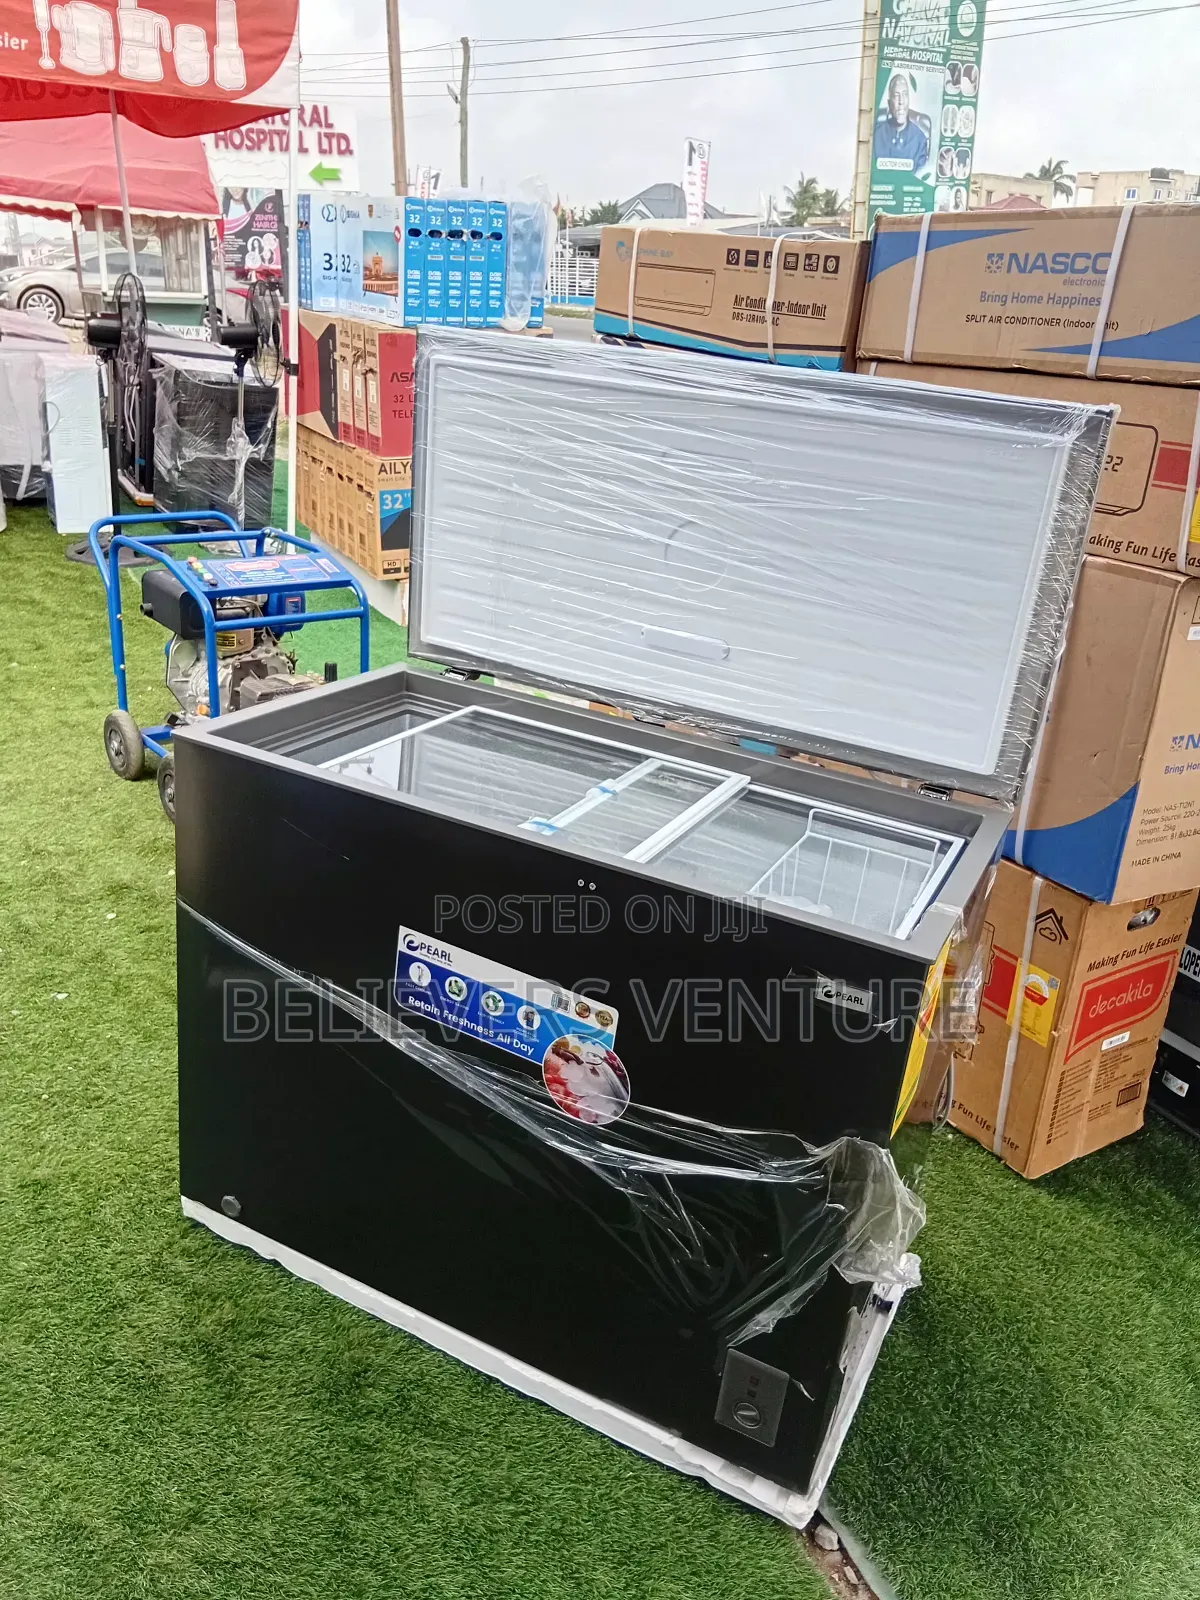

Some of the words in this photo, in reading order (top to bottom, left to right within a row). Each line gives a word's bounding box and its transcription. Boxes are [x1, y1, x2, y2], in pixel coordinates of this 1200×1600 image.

[911, 51, 943, 63] HOSPITAL
[317, 131, 354, 155] LTD.
[409, 214, 421, 224] 32
[430, 215, 442, 225] 32
[451, 216, 462, 226] 32
[472, 217, 483, 226] 32
[492, 218, 503, 228] 32
[322, 252, 338, 272] 3
[1062, 277, 1106, 287] electronic
[733, 294, 745, 307] Air
[811, 303, 827, 317] Unit
[979, 291, 1009, 307] Bring
[1011, 292, 1044, 304] Home
[1046, 293, 1102, 309] Happines
[965, 314, 987, 324] SPLIT
[988, 316, 1002, 325] AIR
[1004, 316, 1062, 327] CONDITIONER
[393, 395, 404, 404] 32
[378, 461, 413, 476] AILY
[1125, 541, 1149, 556] Fun
[1152, 546, 1177, 564] Life
[1164, 765, 1185, 775] Bring
[1131, 856, 1152, 868] MADE
[1152, 855, 1161, 863] IN
[1161, 851, 1182, 862] CHINA
[419, 941, 453, 964] PEARL
[1087, 952, 1121, 973] Making
[1120, 947, 1137, 961] Fun
[1139, 941, 1156, 955] Life
[1156, 933, 1183, 948] Easier
[835, 991, 865, 1006] PEARL
[1088, 978, 1154, 1018] decakila
[408, 995, 441, 1017] Retain
[443, 1010, 495, 1038] Freshness
[496, 1032, 511, 1046] All
[513, 1038, 535, 1056] Day
[957, 1102, 974, 1119] Fun
[974, 1114, 991, 1132] Life
